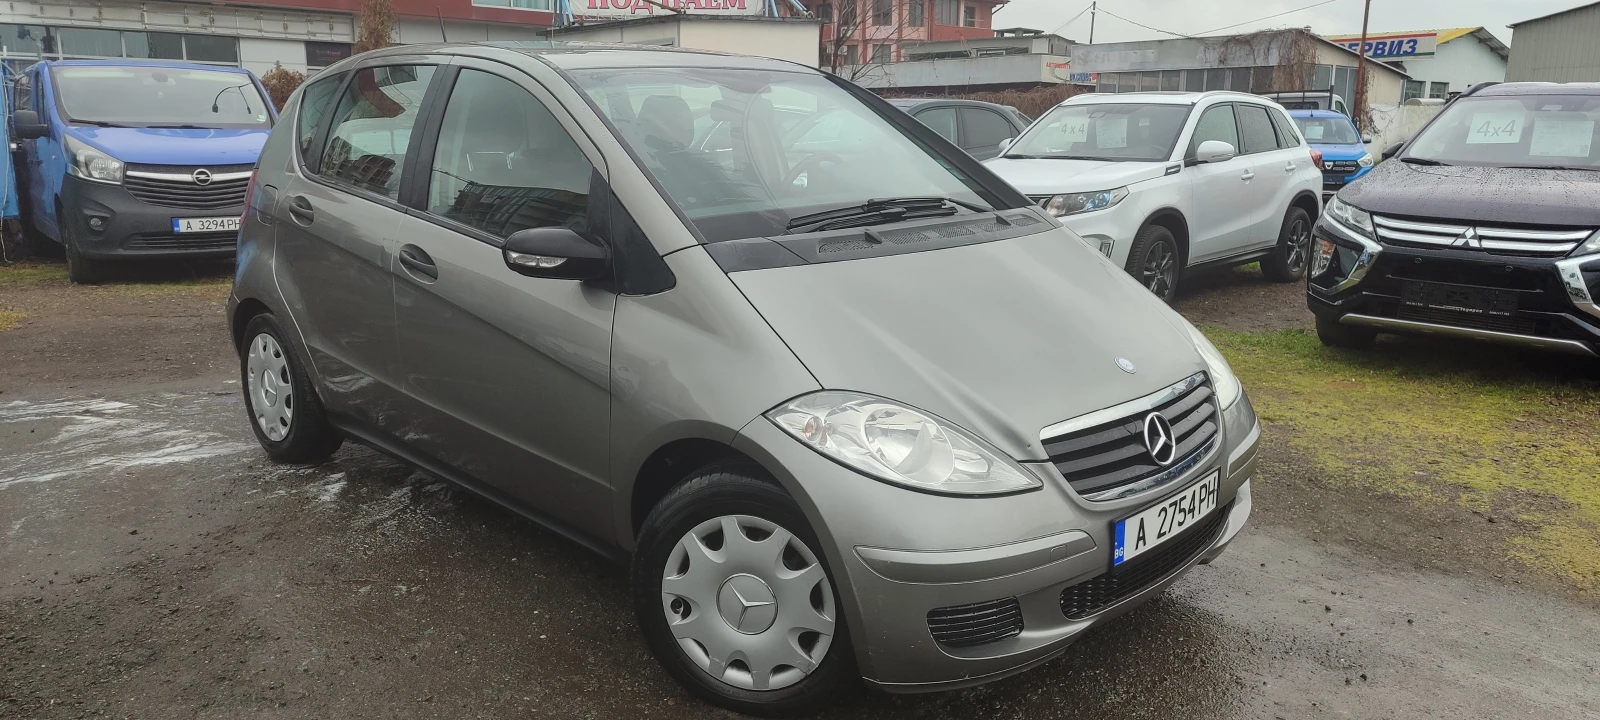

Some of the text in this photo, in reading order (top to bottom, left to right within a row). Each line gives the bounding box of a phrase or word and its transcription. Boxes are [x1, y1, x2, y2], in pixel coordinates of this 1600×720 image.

[1476, 119, 1516, 137] 4x4
[1135, 516, 1146, 551] A
[1114, 546, 1124, 559] BG
